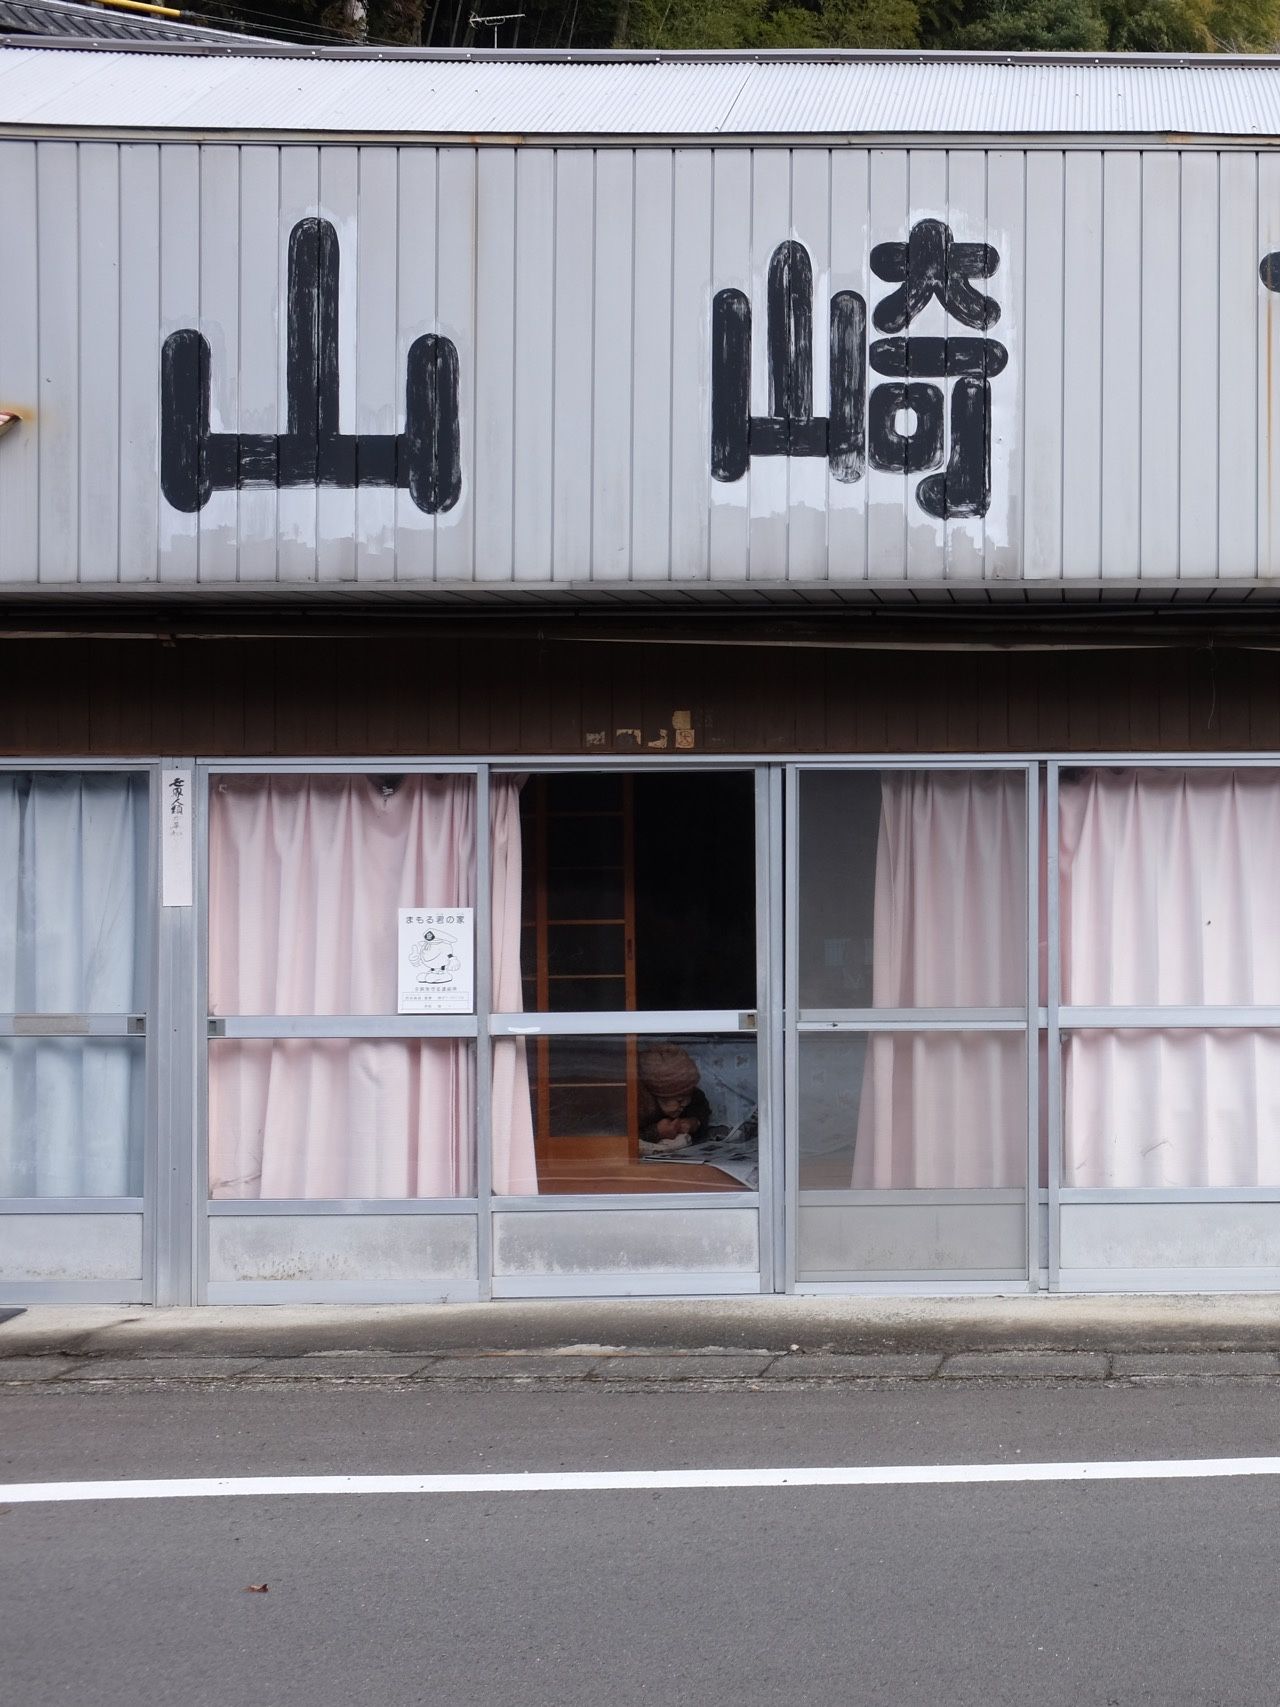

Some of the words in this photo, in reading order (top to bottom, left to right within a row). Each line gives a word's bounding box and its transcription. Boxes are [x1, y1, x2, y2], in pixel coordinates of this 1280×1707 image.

[405, 915, 465, 924] まもる君の家
